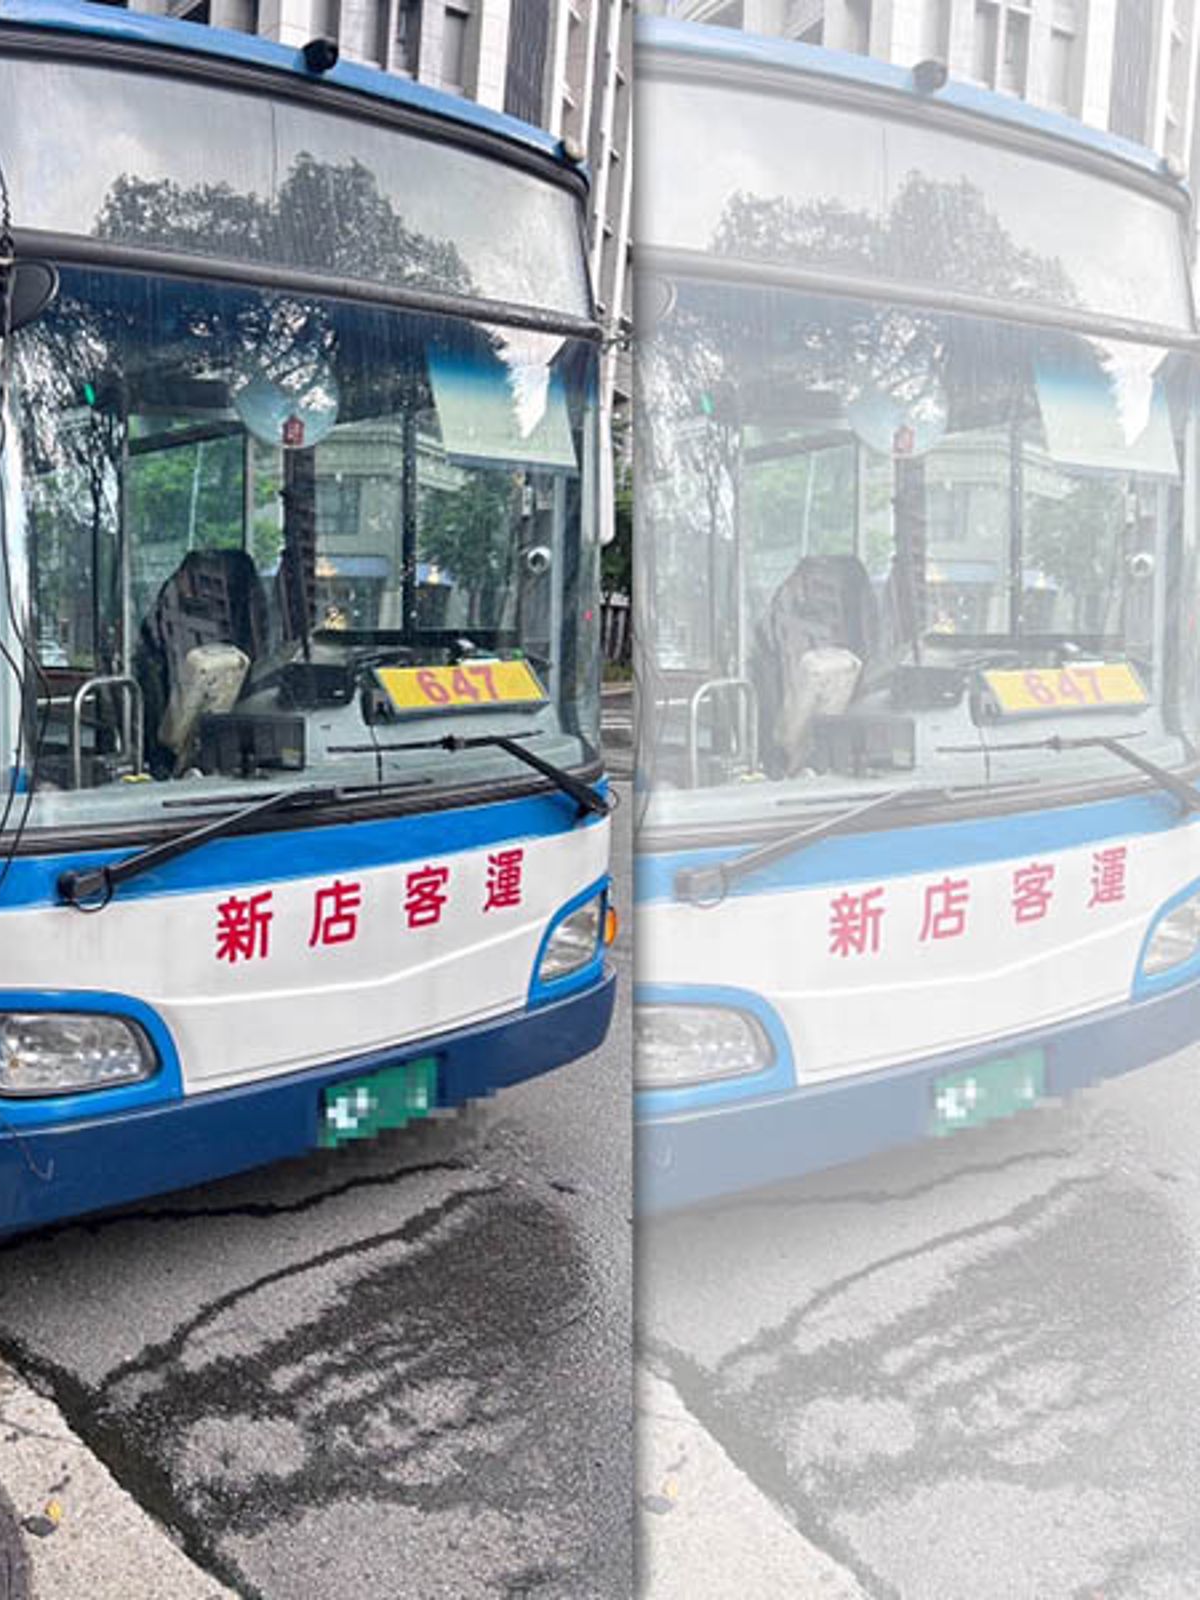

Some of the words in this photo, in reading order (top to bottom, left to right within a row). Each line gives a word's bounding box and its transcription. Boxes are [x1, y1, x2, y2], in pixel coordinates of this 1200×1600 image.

[416, 665, 500, 705] 647
[1023, 668, 1104, 704] 647
[215, 847, 525, 965] 新店客運
[828, 847, 1127, 957] 新店客運
